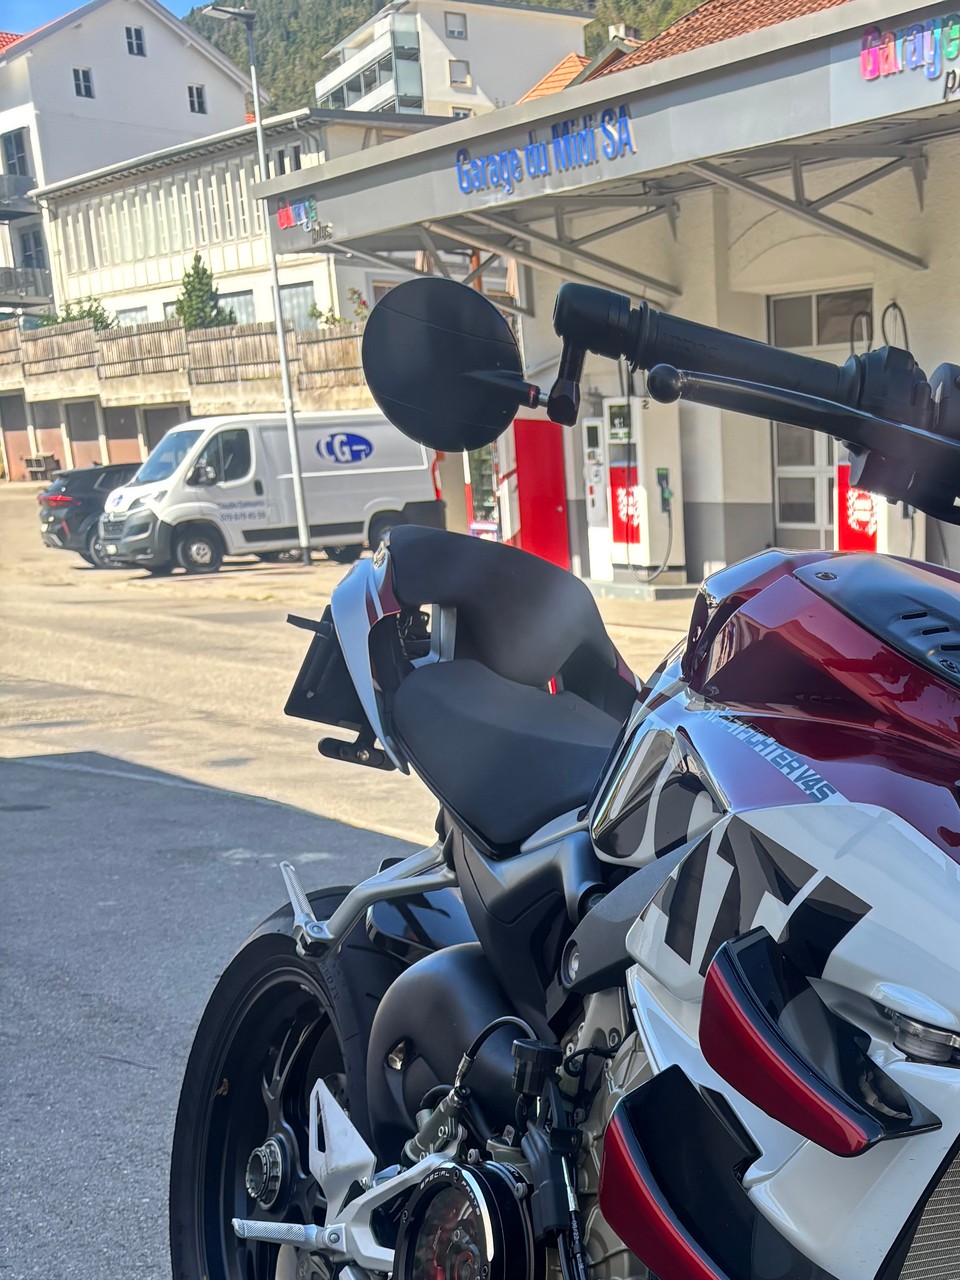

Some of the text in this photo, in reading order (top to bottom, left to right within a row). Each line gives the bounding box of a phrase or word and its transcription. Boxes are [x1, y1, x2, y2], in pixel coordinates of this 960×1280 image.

[456, 104, 637, 194] Garage du Midi SA
